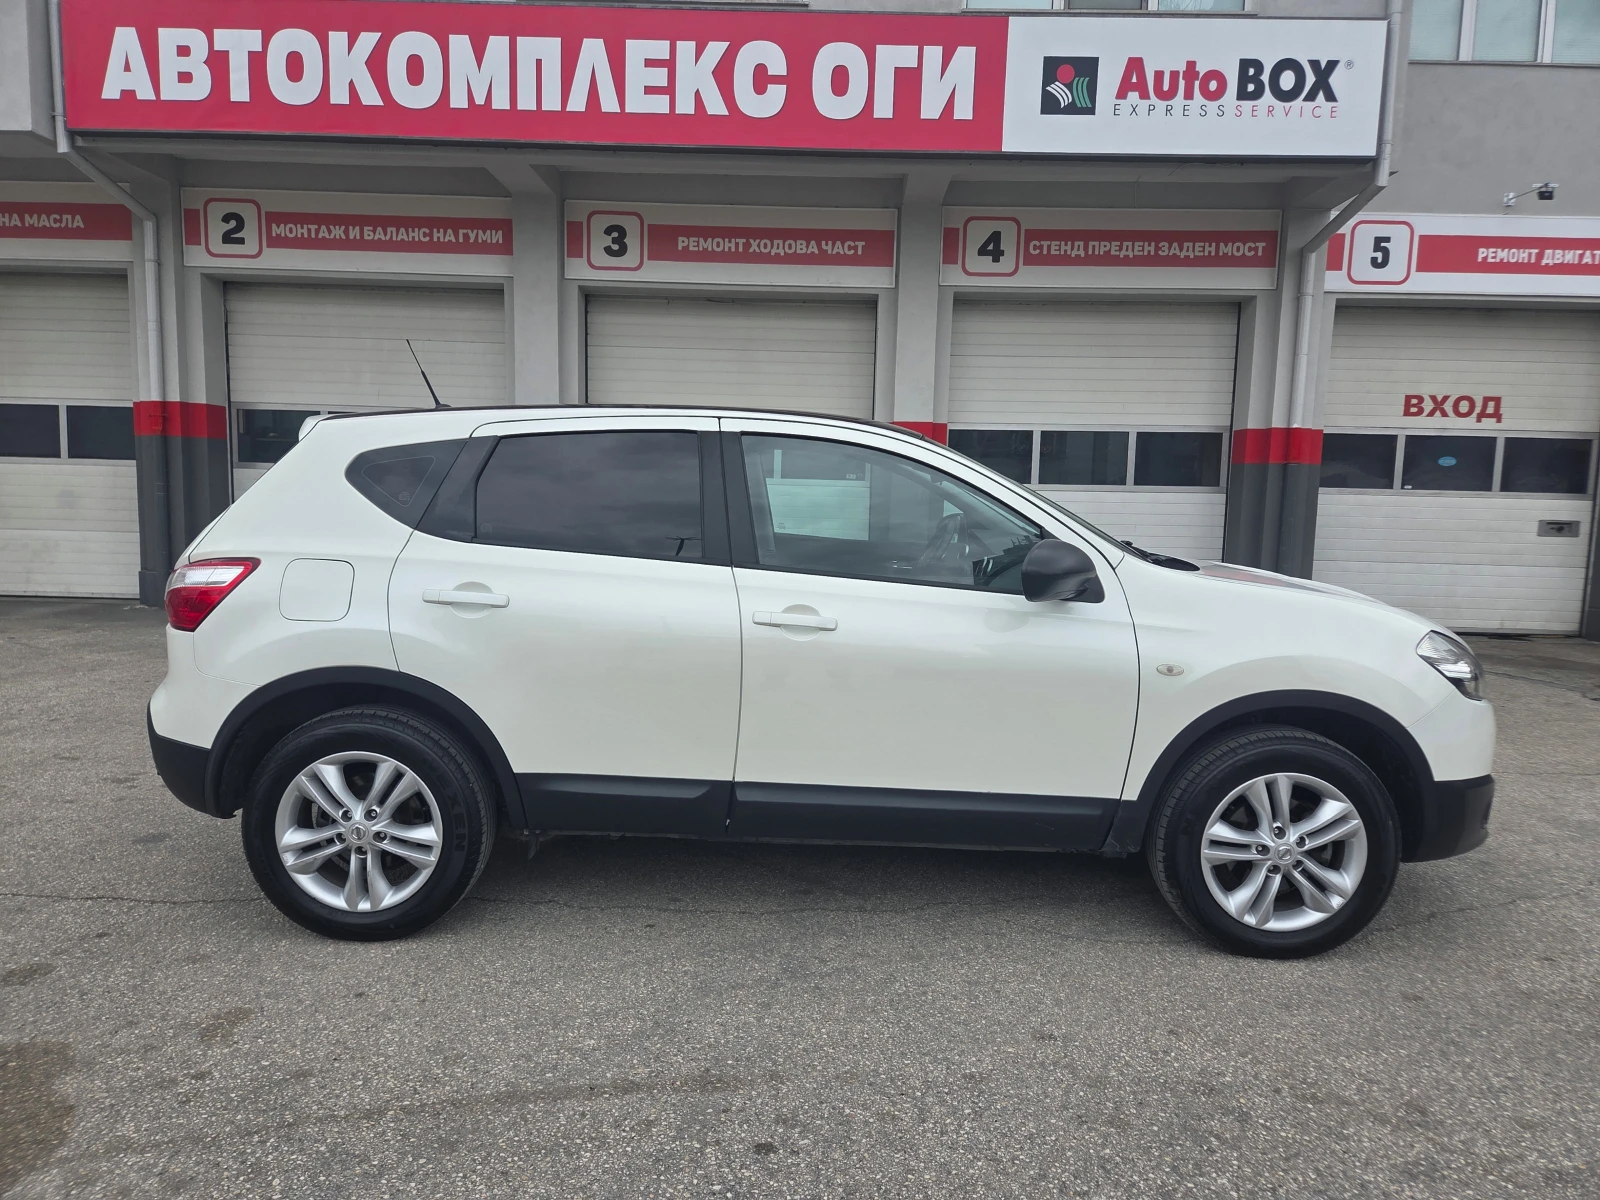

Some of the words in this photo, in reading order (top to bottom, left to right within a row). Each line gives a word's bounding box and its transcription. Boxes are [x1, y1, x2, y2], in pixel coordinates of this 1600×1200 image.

[101, 26, 788, 118] АВТОКОМПЛЕКС
[812, 42, 977, 121] ОГИ
[1114, 56, 1228, 102] Auto
[1236, 57, 1341, 103] BOX
[0, 213, 22, 227] НА
[24, 213, 85, 228] МАСЛА
[220, 212, 246, 245] 2
[271, 223, 346, 239] МОНТАЖ
[349, 226, 361, 239] И
[363, 226, 430, 242] БАЛАНС
[433, 228, 456, 242] НА
[459, 228, 503, 244] ГУМИ
[603, 224, 628, 258] 3
[678, 236, 746, 252] РЕМОНТ
[749, 238, 819, 256] ХОДОВА
[821, 241, 865, 255] ЧАСТ
[977, 230, 1005, 263] 4
[1029, 240, 1085, 258] СТЕНД
[1088, 241, 1155, 258] ПРЕДЕН
[1158, 242, 1216, 258] ЗАДЕН
[1219, 242, 1266, 256] МОСТ
[1370, 236, 1391, 269] 5
[1477, 247, 1539, 263] РЕМОНТ
[1541, 249, 1600, 266] ДВИГАТ
[1402, 394, 1503, 423] ВХОД
